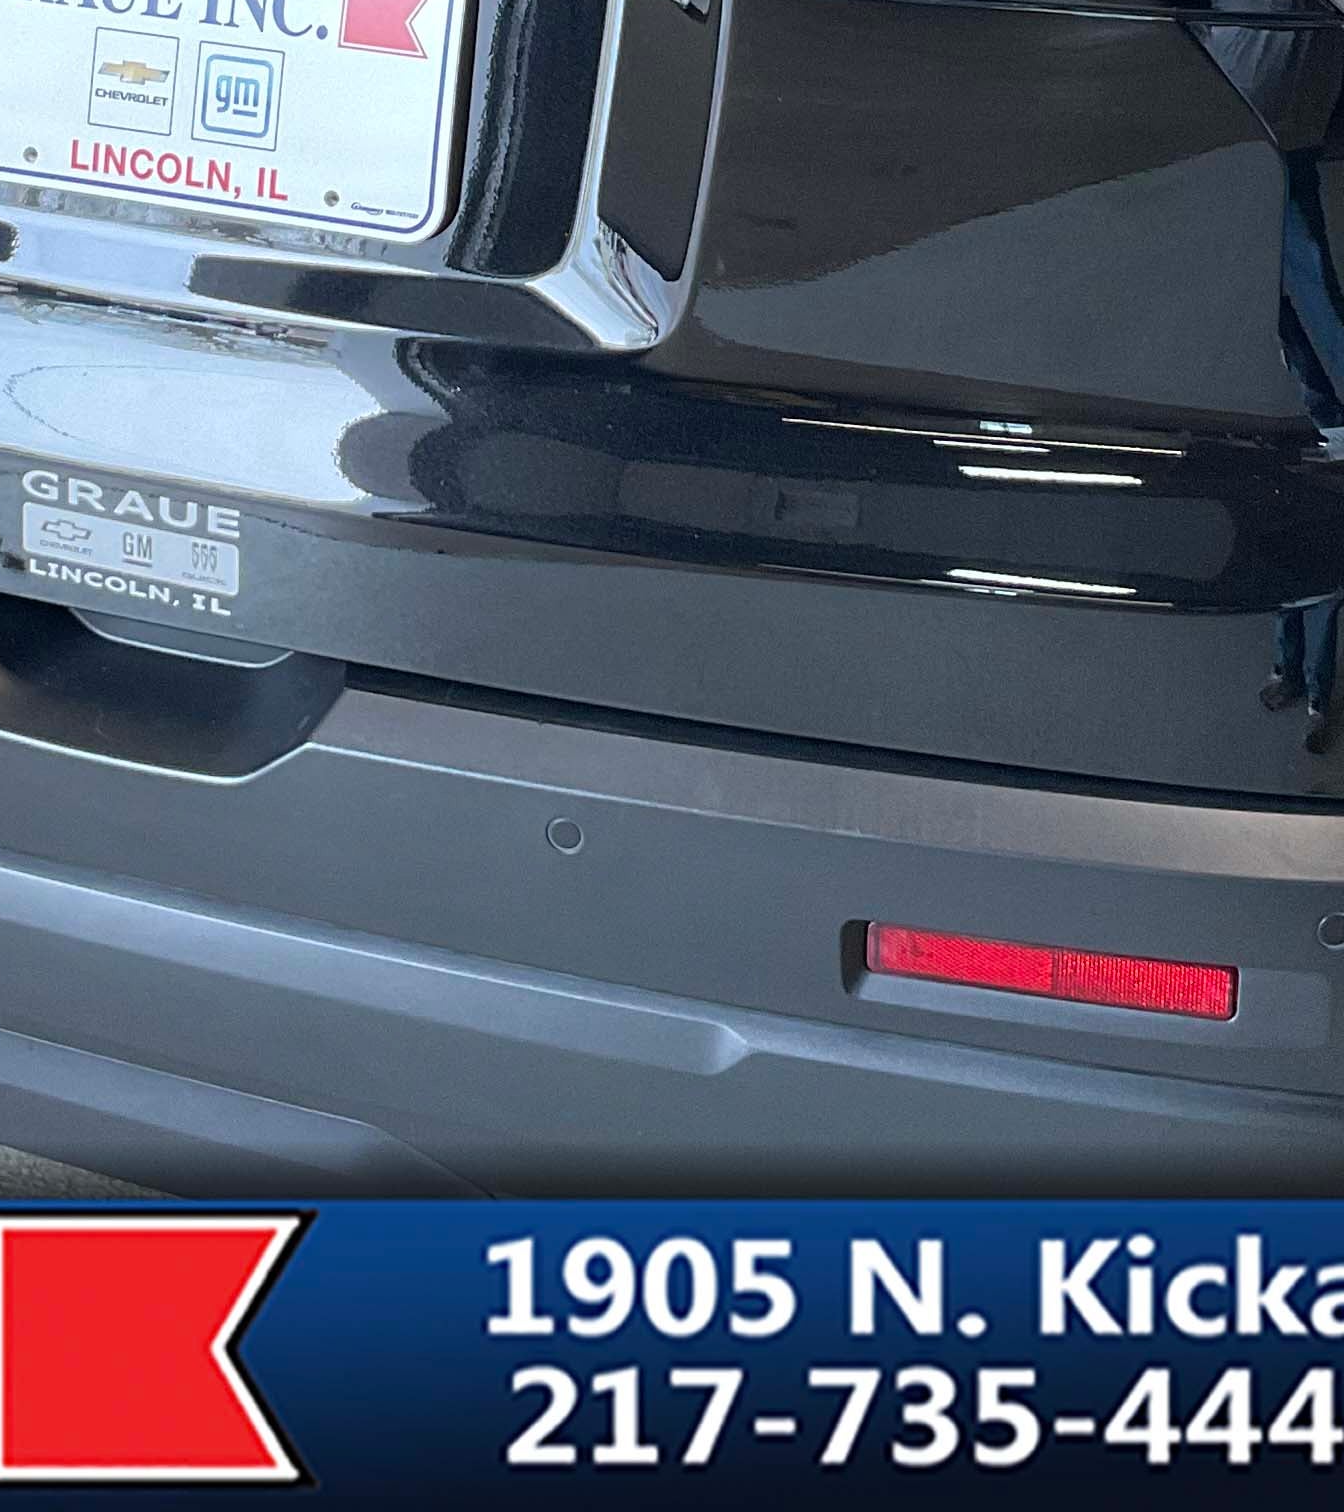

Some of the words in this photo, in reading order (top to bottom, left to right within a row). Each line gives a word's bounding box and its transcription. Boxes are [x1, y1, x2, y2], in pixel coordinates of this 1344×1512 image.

[94, 86, 169, 108] CHEVROLET
[215, 74, 262, 118] gm
[69, 139, 242, 200] LINCOLN,
[255, 167, 289, 201] IL
[21, 469, 241, 539] GRAUE
[122, 531, 153, 561] GM
[28, 557, 181, 607] LINCOLN,
[192, 592, 232, 617] IL
